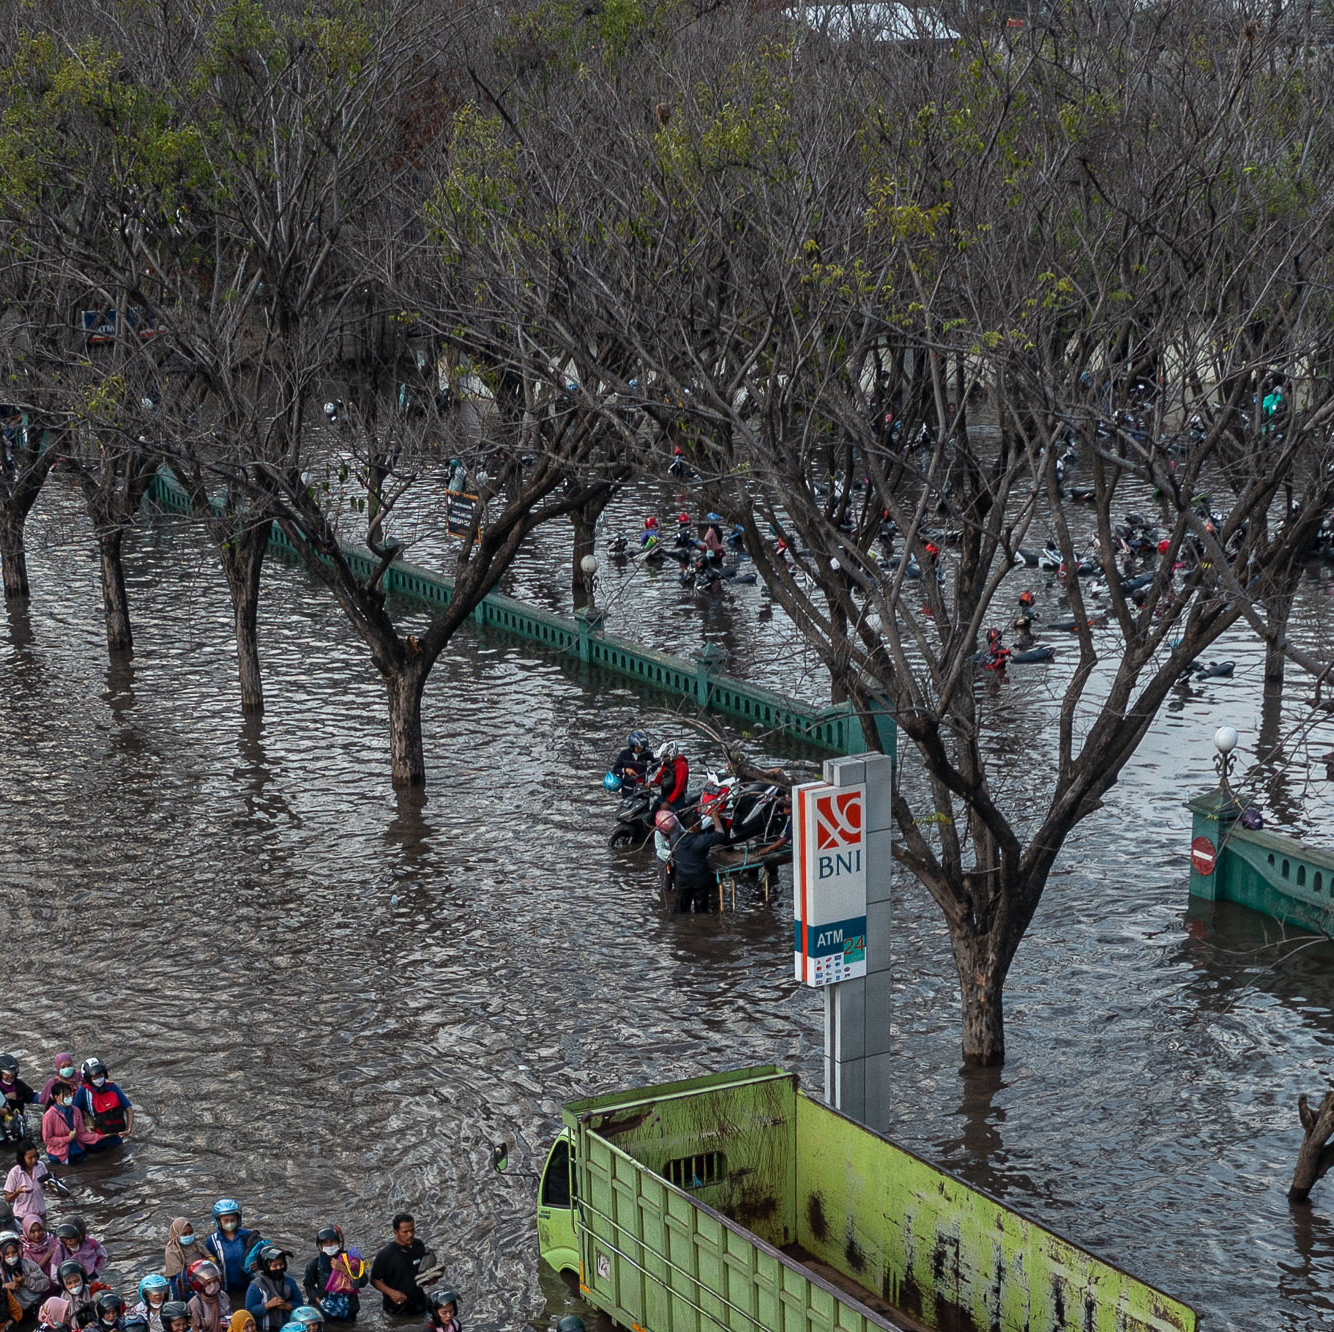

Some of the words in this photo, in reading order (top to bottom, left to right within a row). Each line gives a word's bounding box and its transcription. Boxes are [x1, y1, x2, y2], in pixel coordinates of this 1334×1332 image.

[818, 849, 862, 880] BNI
[817, 928, 844, 949] ATM
[844, 935, 864, 956] 24
